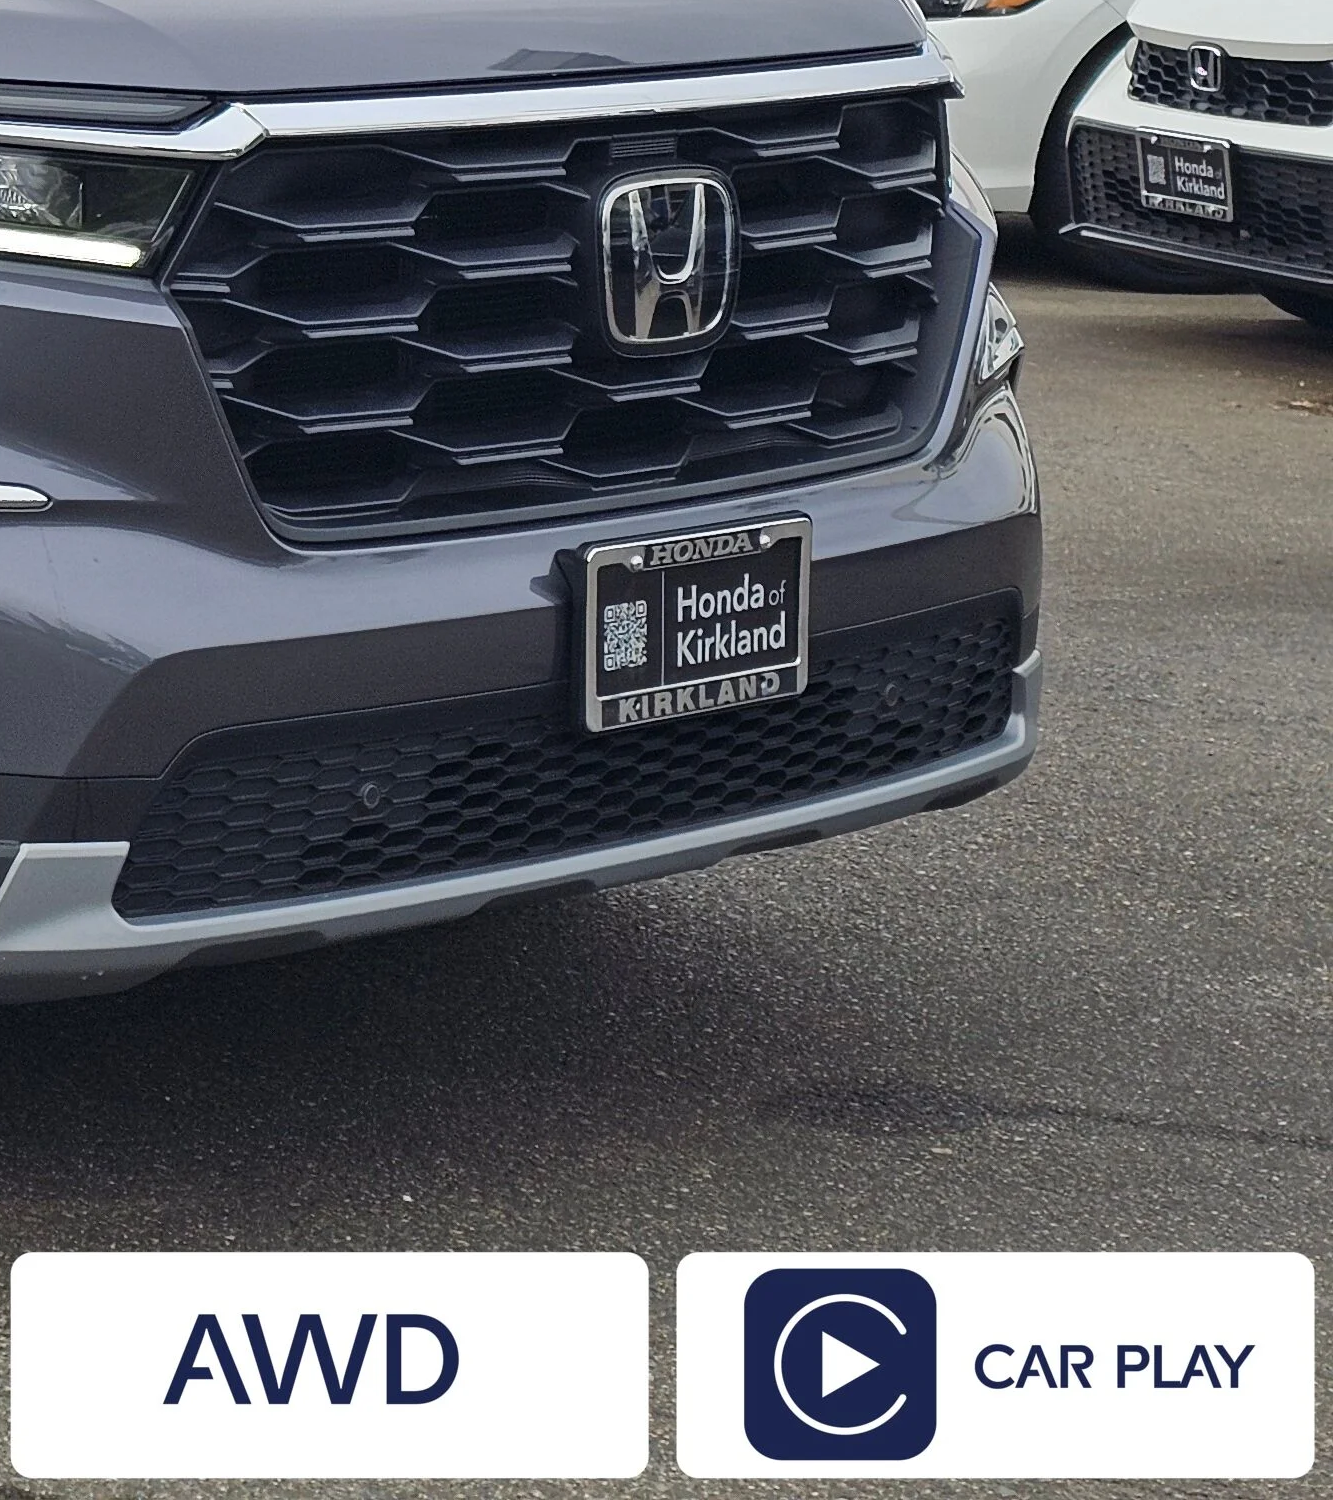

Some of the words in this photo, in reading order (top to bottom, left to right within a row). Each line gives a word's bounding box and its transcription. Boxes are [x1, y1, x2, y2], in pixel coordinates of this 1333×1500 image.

[1174, 155, 1214, 178] Honda
[1176, 175, 1225, 200] Kirkland
[649, 533, 754, 566] HONDA
[676, 573, 765, 623] Honda
[768, 579, 787, 607] of
[676, 610, 786, 668] Kirkland
[618, 671, 781, 724] KIRKLAND
